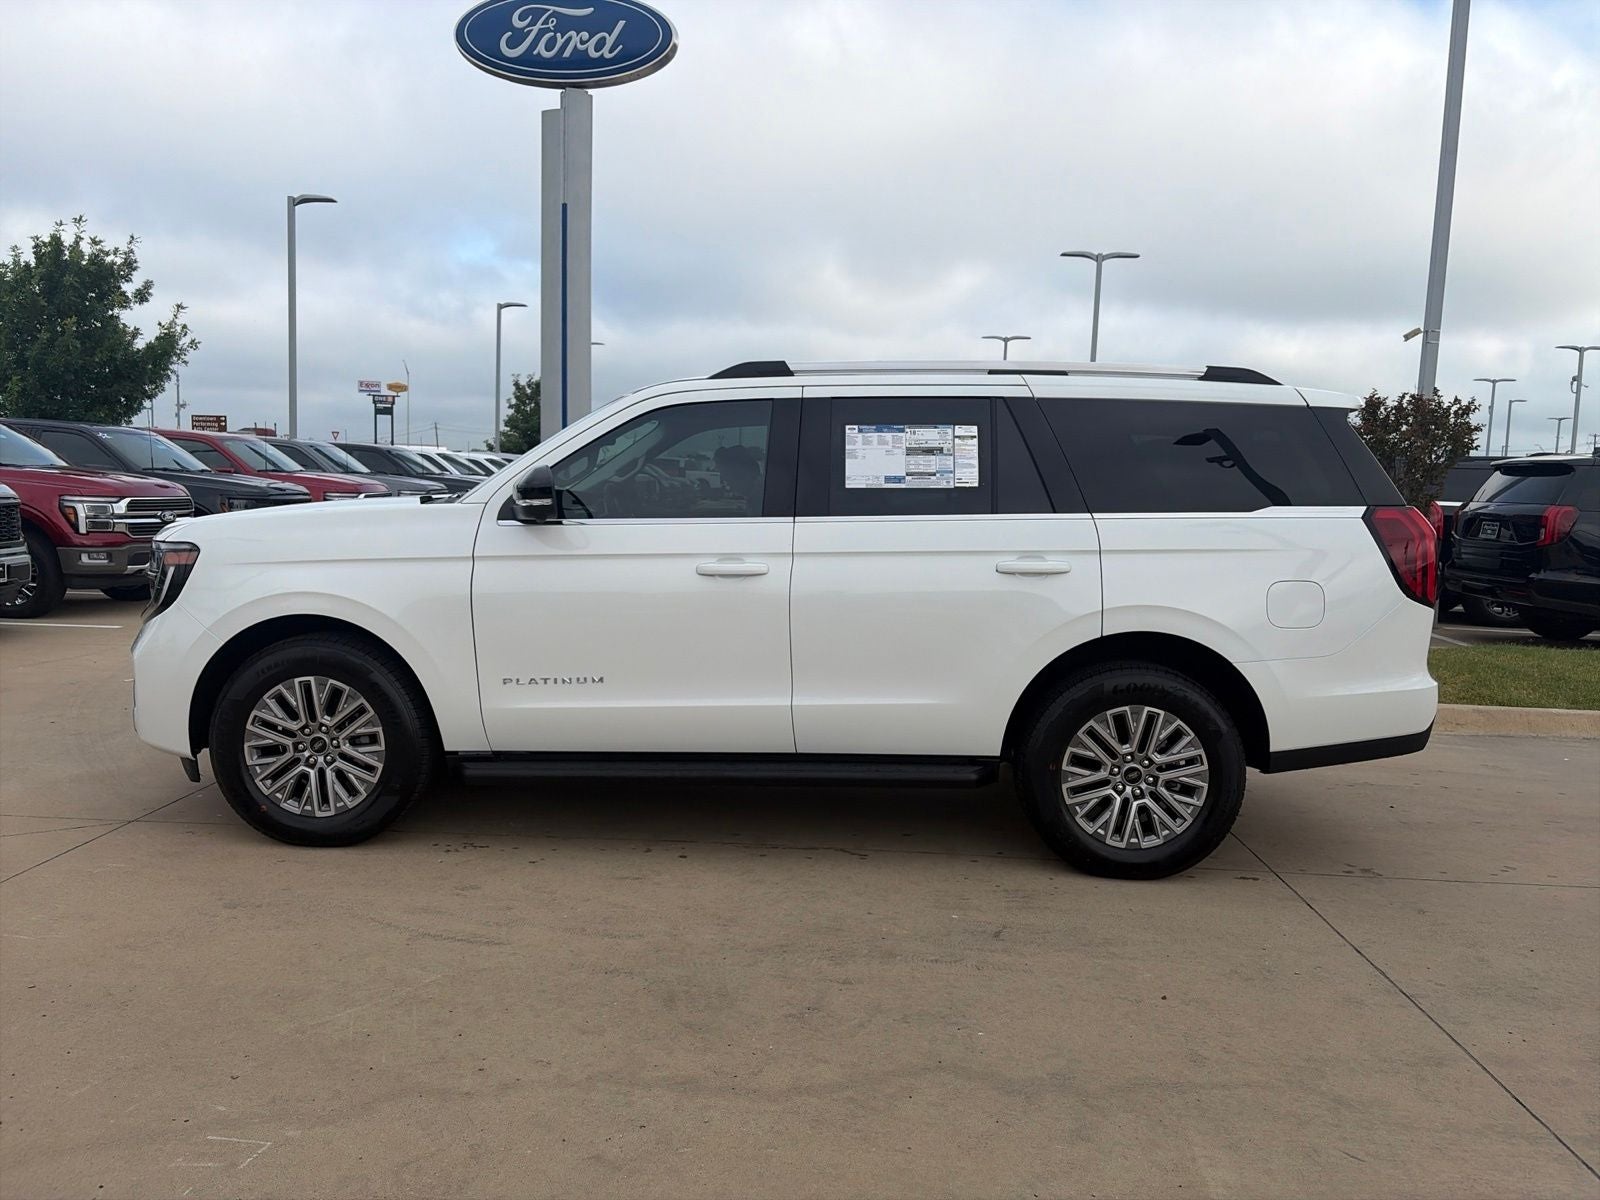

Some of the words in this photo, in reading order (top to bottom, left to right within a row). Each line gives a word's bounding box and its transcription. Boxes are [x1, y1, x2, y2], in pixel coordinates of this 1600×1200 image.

[500, 5, 626, 59] Ford
[359, 382, 380, 390] Exxon
[502, 676, 604, 686] PLATINUM
